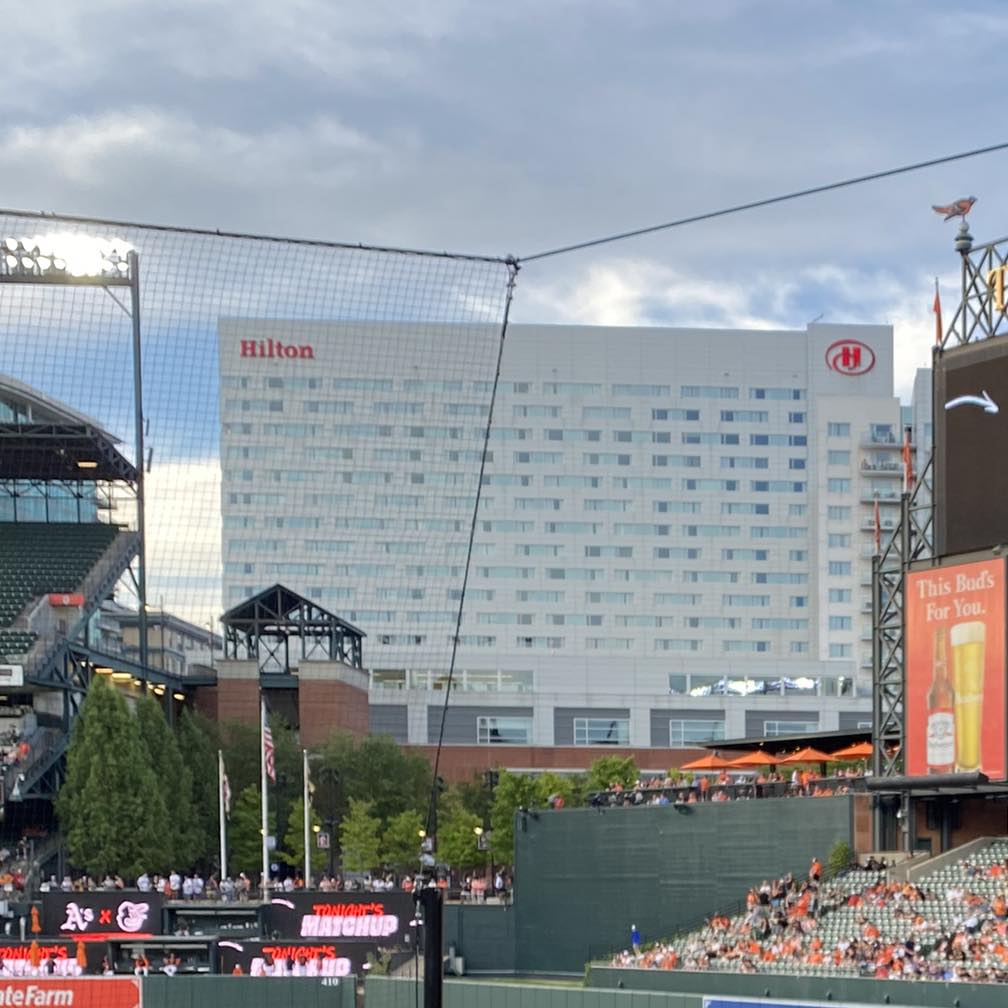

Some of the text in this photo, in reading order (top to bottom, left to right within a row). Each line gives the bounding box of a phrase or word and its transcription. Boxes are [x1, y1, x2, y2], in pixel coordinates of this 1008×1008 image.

[240, 337, 314, 359] Hilton
[916, 570, 996, 600] This Bud's
[926, 598, 987, 622] For You.
[60, 902, 94, 931] A's
[312, 902, 384, 916] TONIGHT'S
[300, 914, 399, 937] MATCHUP
[321, 977, 339, 986] 410
